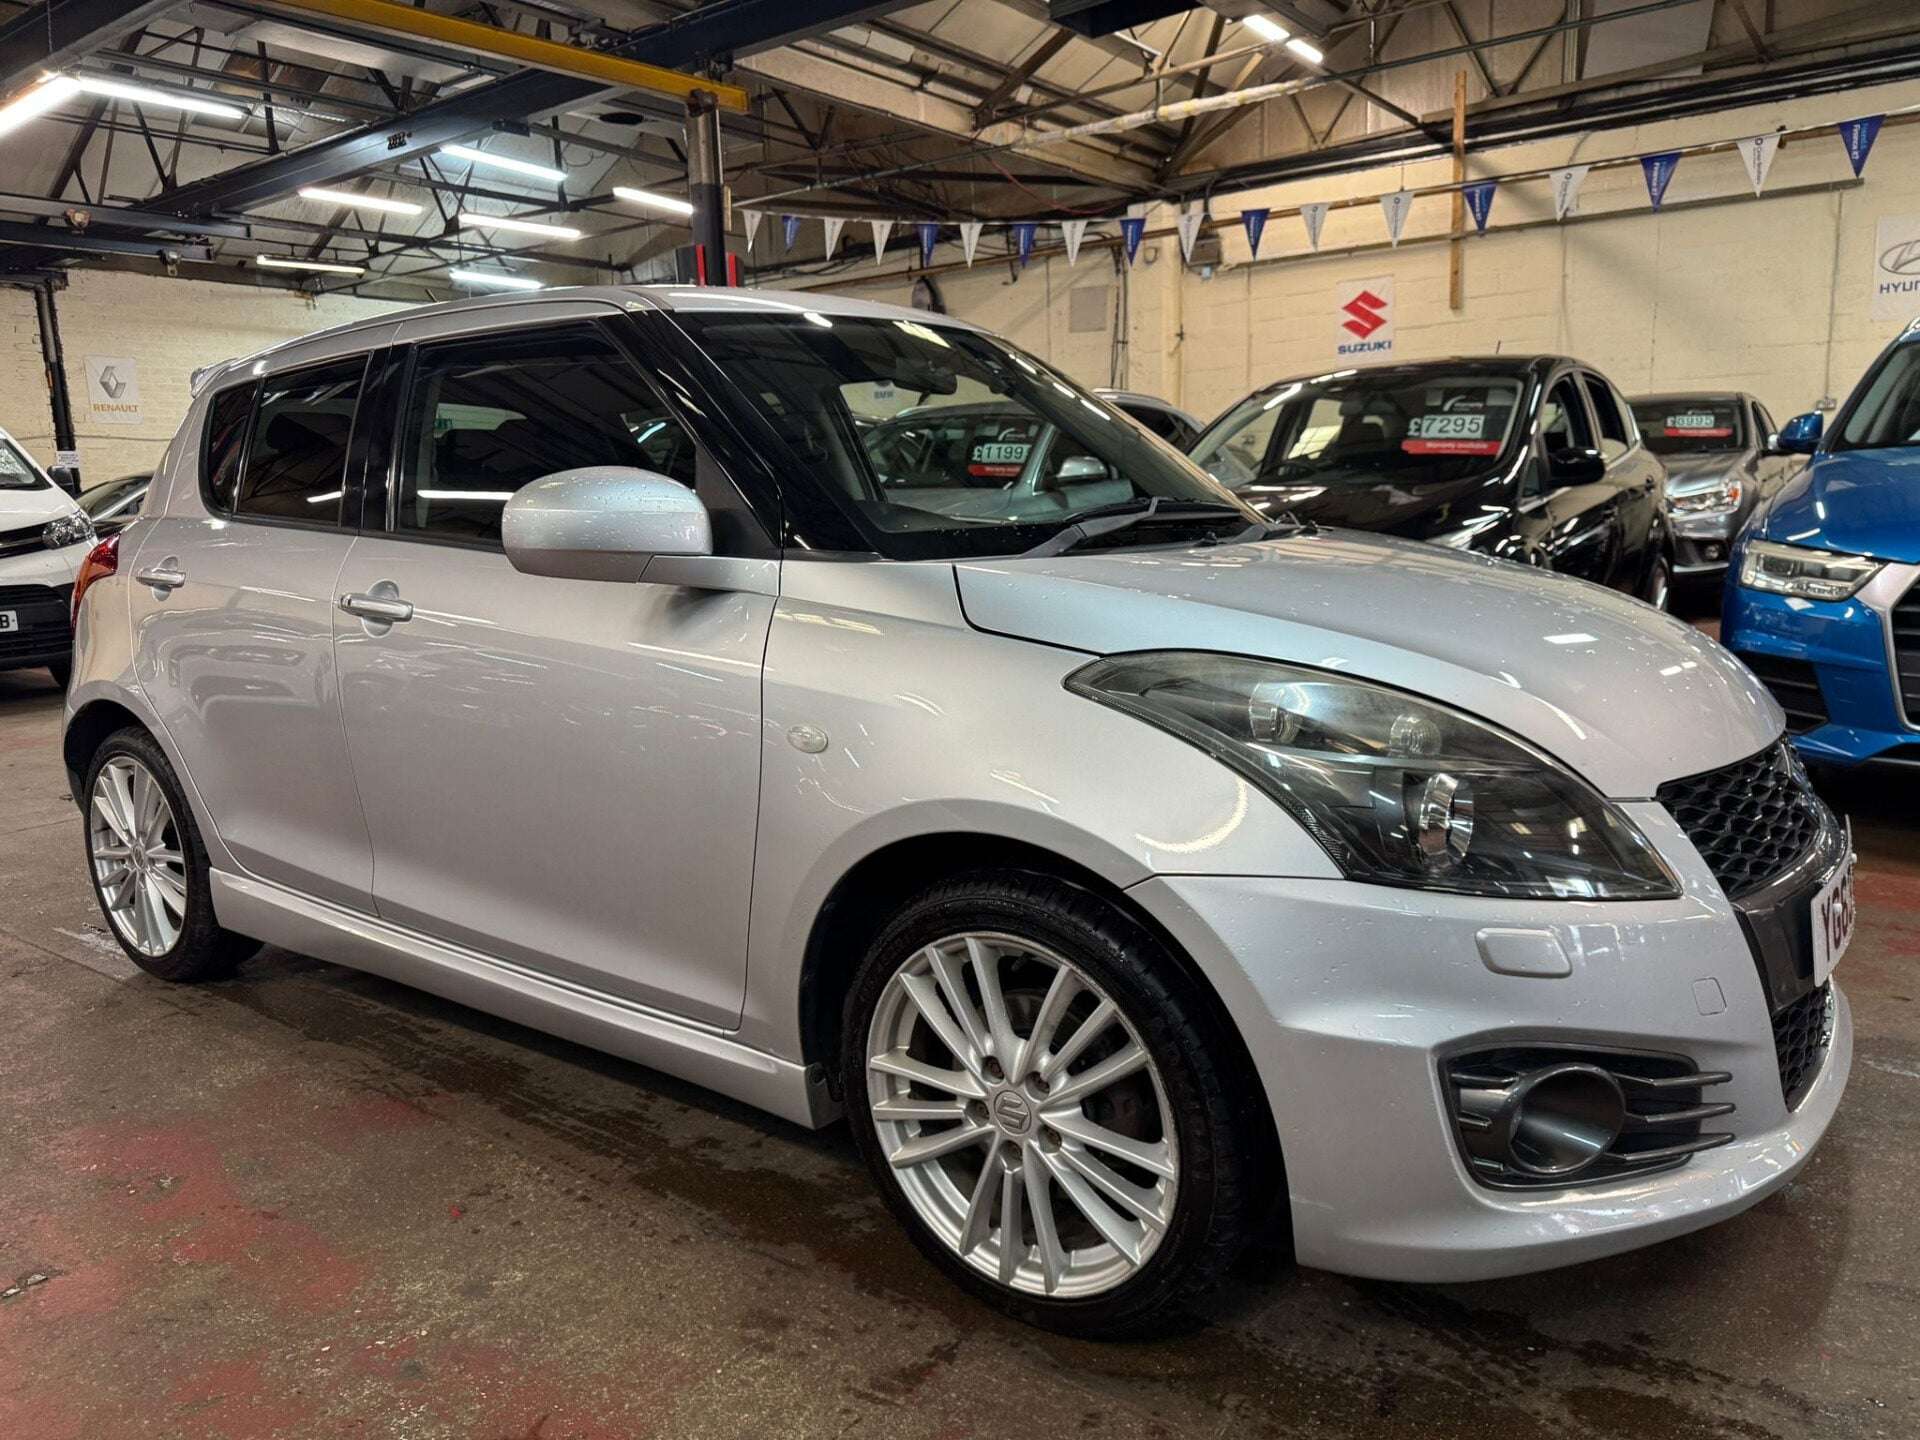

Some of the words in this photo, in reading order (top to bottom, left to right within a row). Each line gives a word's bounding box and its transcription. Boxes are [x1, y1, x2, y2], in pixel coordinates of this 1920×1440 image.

[1337, 340, 1392, 354] SUZUKI
[92, 403, 138, 413] RENAULT
[1407, 417, 1481, 437] £7295
[972, 444, 1027, 461] £1199
